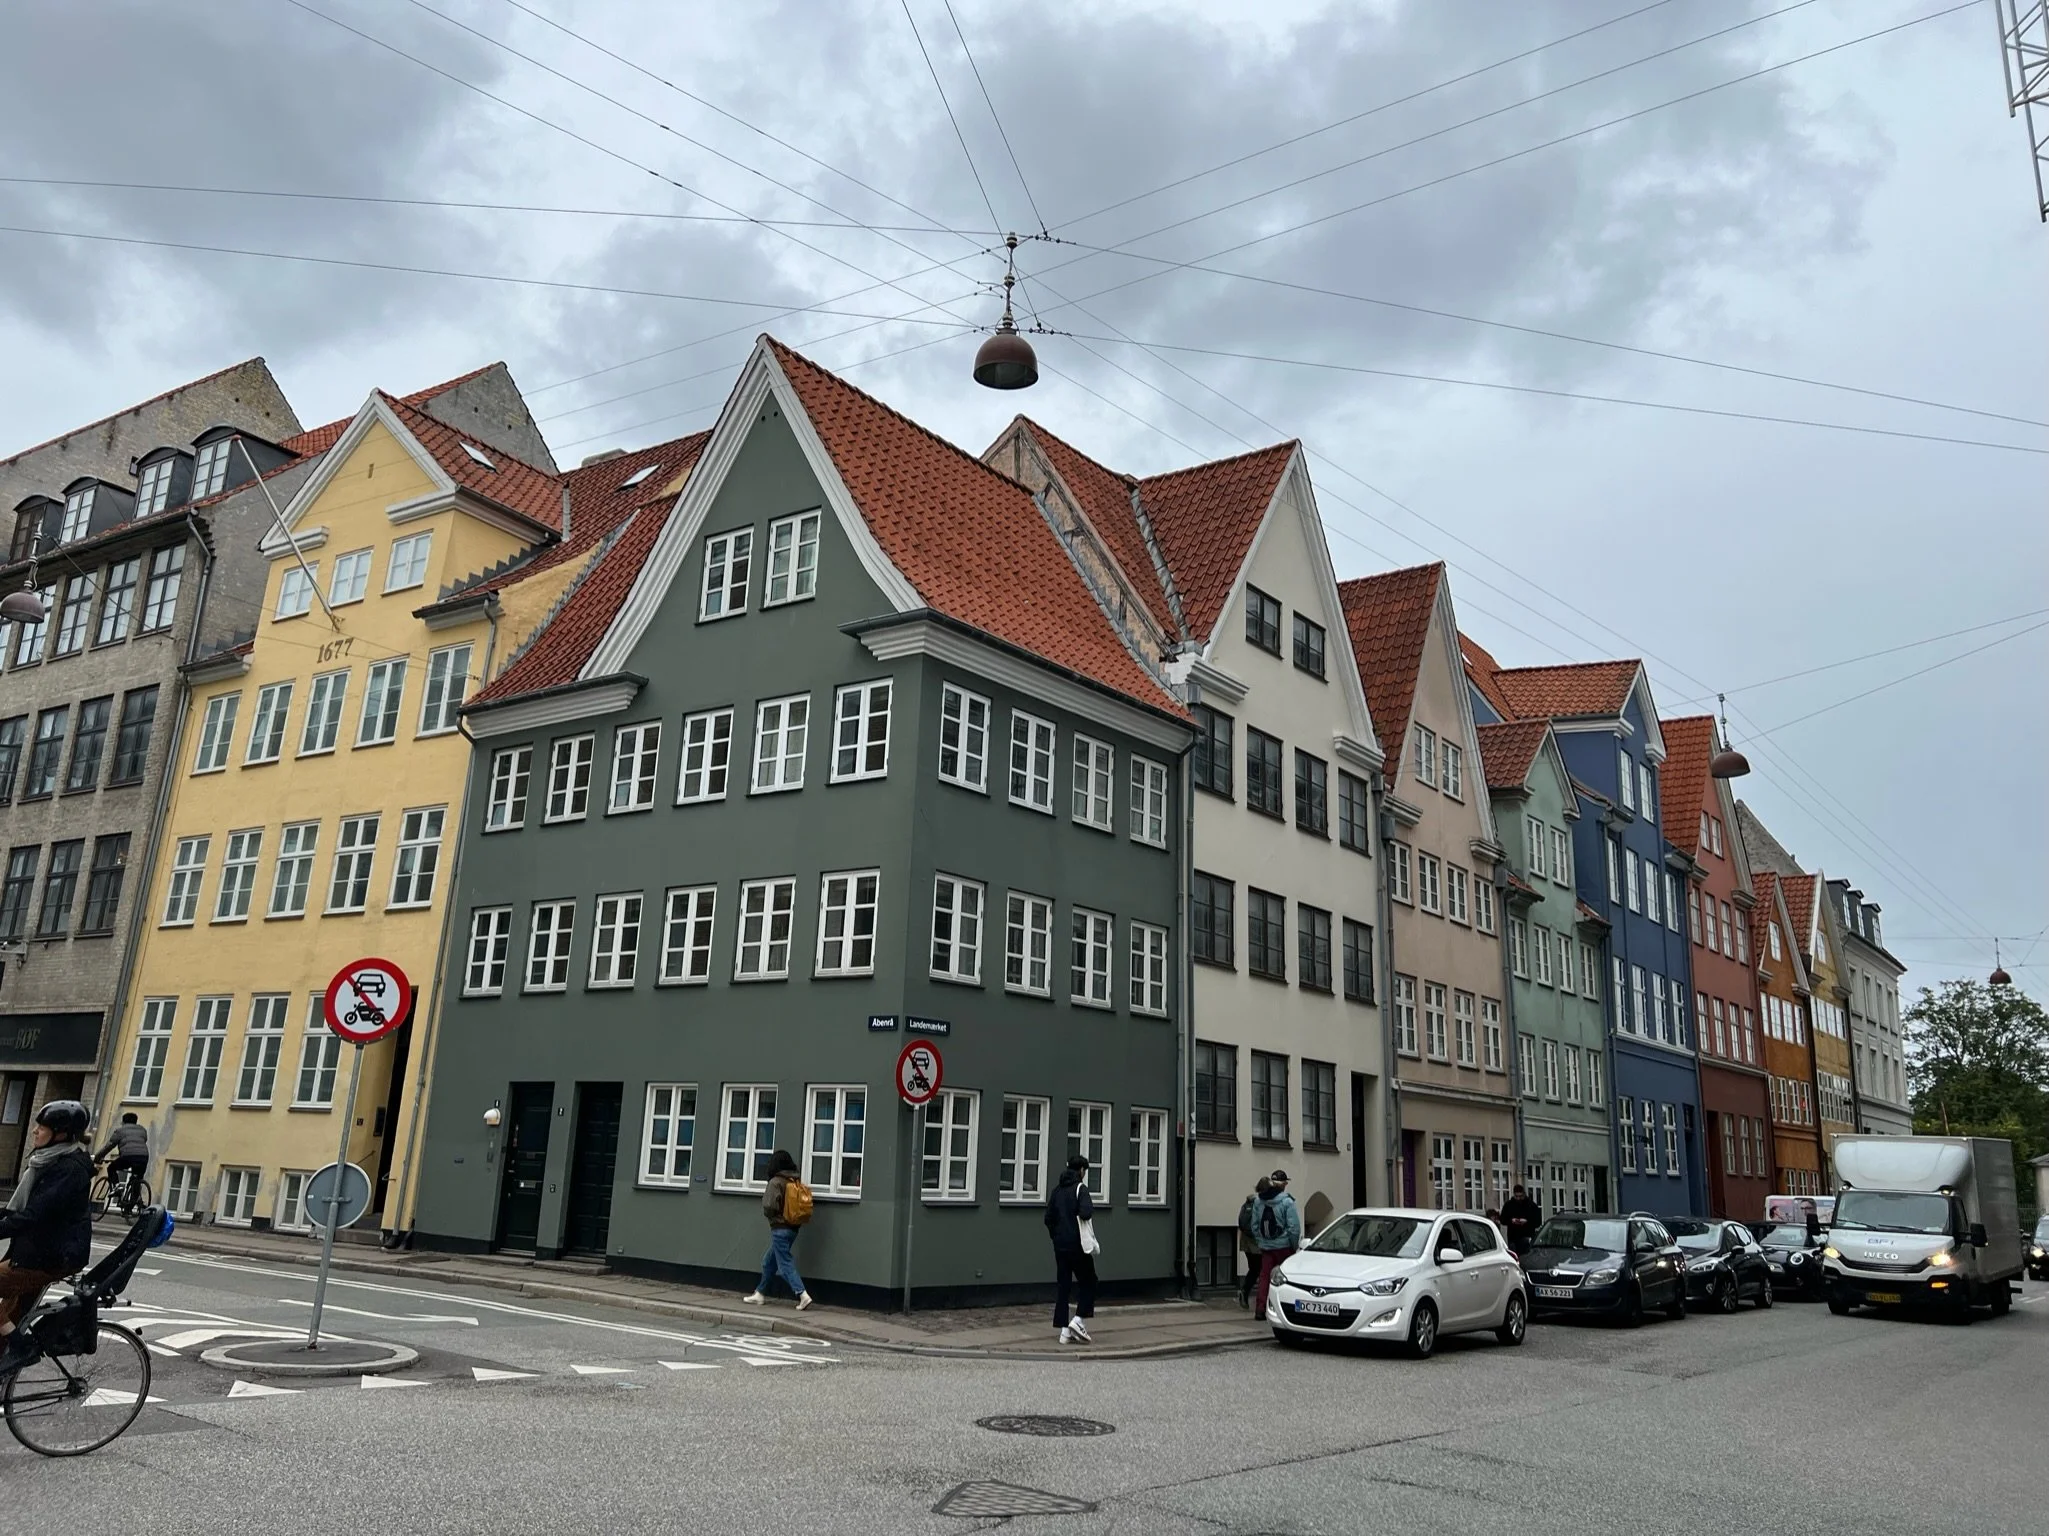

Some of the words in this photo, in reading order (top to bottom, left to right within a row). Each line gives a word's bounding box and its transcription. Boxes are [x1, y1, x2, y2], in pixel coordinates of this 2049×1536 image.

[317, 637, 354, 664] 1677
[909, 1019, 947, 1032] Landemærket
[1864, 1251, 1899, 1260] IVECO
[1300, 1301, 1311, 1312] DC
[1312, 1302, 1322, 1312] 73
[1323, 1303, 1338, 1314] 440
